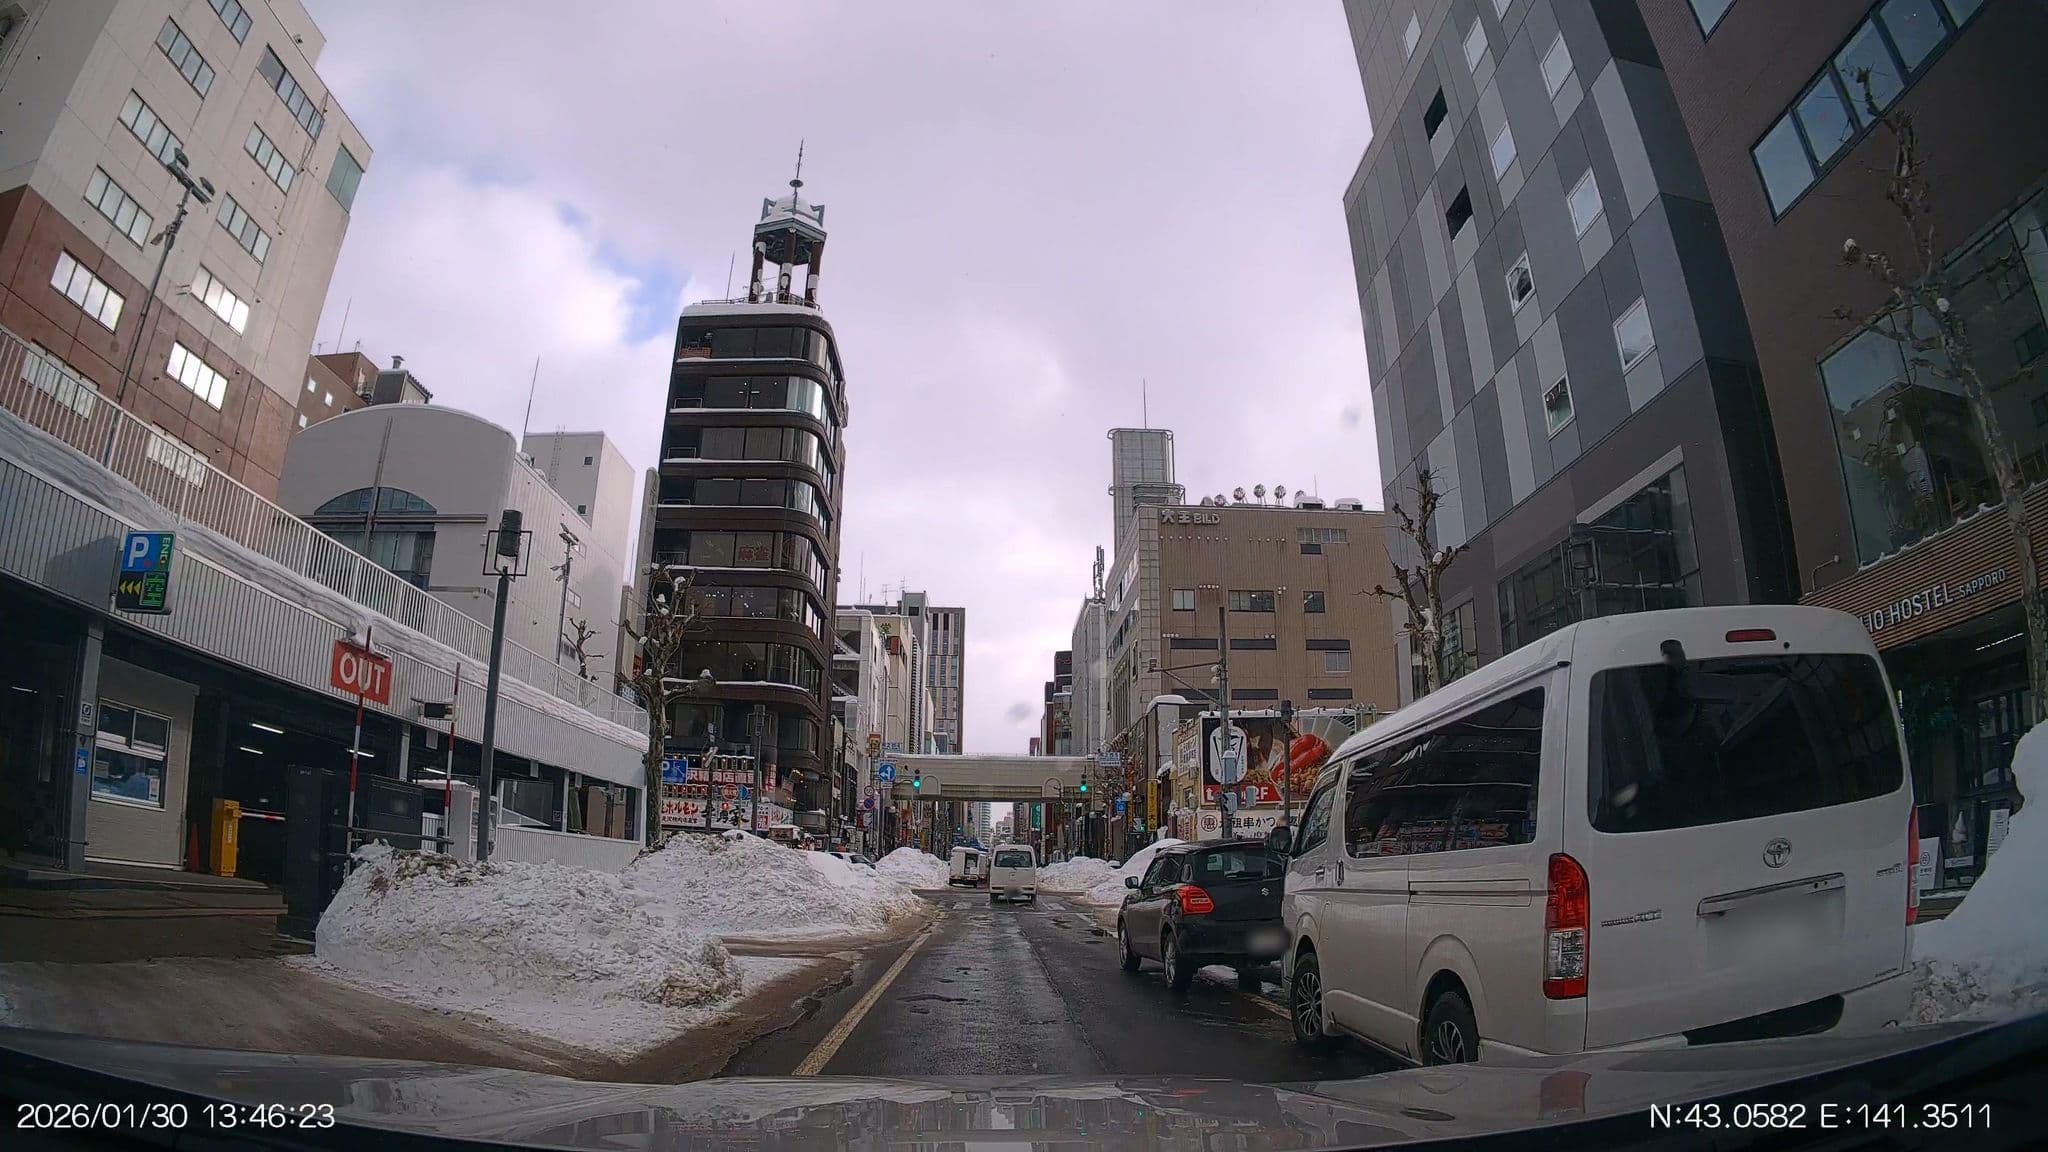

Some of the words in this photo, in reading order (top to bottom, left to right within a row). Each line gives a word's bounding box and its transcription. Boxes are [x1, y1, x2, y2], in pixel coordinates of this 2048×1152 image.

[128, 536, 150, 568] P
[1889, 582, 1954, 625] HOSTEL
[1959, 568, 2006, 598] SAPPORO
[340, 652, 386, 695] OUT
